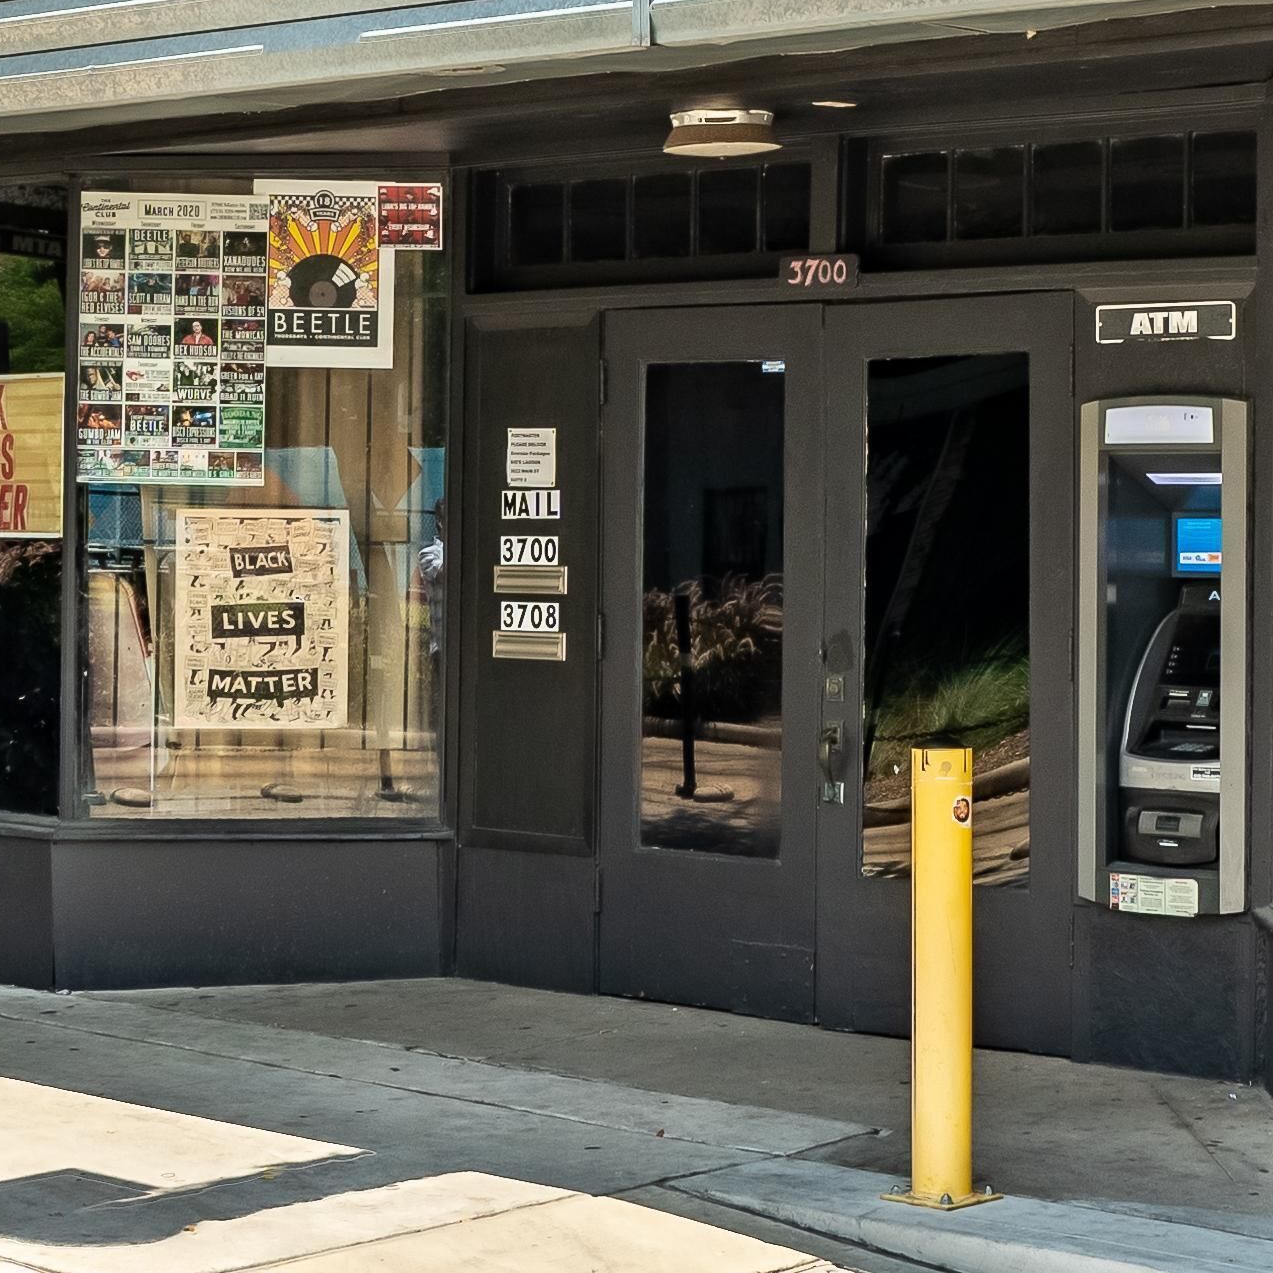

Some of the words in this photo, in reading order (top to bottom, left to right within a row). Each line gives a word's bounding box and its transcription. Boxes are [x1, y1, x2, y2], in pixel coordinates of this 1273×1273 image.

[177, 205, 200, 218] 2020
[134, 230, 168, 241] BEETLE
[788, 259, 847, 287] 3700
[274, 313, 371, 334] BEETLE
[1130, 310, 1198, 335] ATM
[130, 420, 164, 431] BEETLE
[504, 492, 558, 516] MAIL
[234, 551, 289, 570] BLACK
[503, 538, 556, 562] 3700
[222, 610, 296, 630] LIVES
[503, 604, 557, 628] 3708
[211, 672, 313, 694] MATTER
